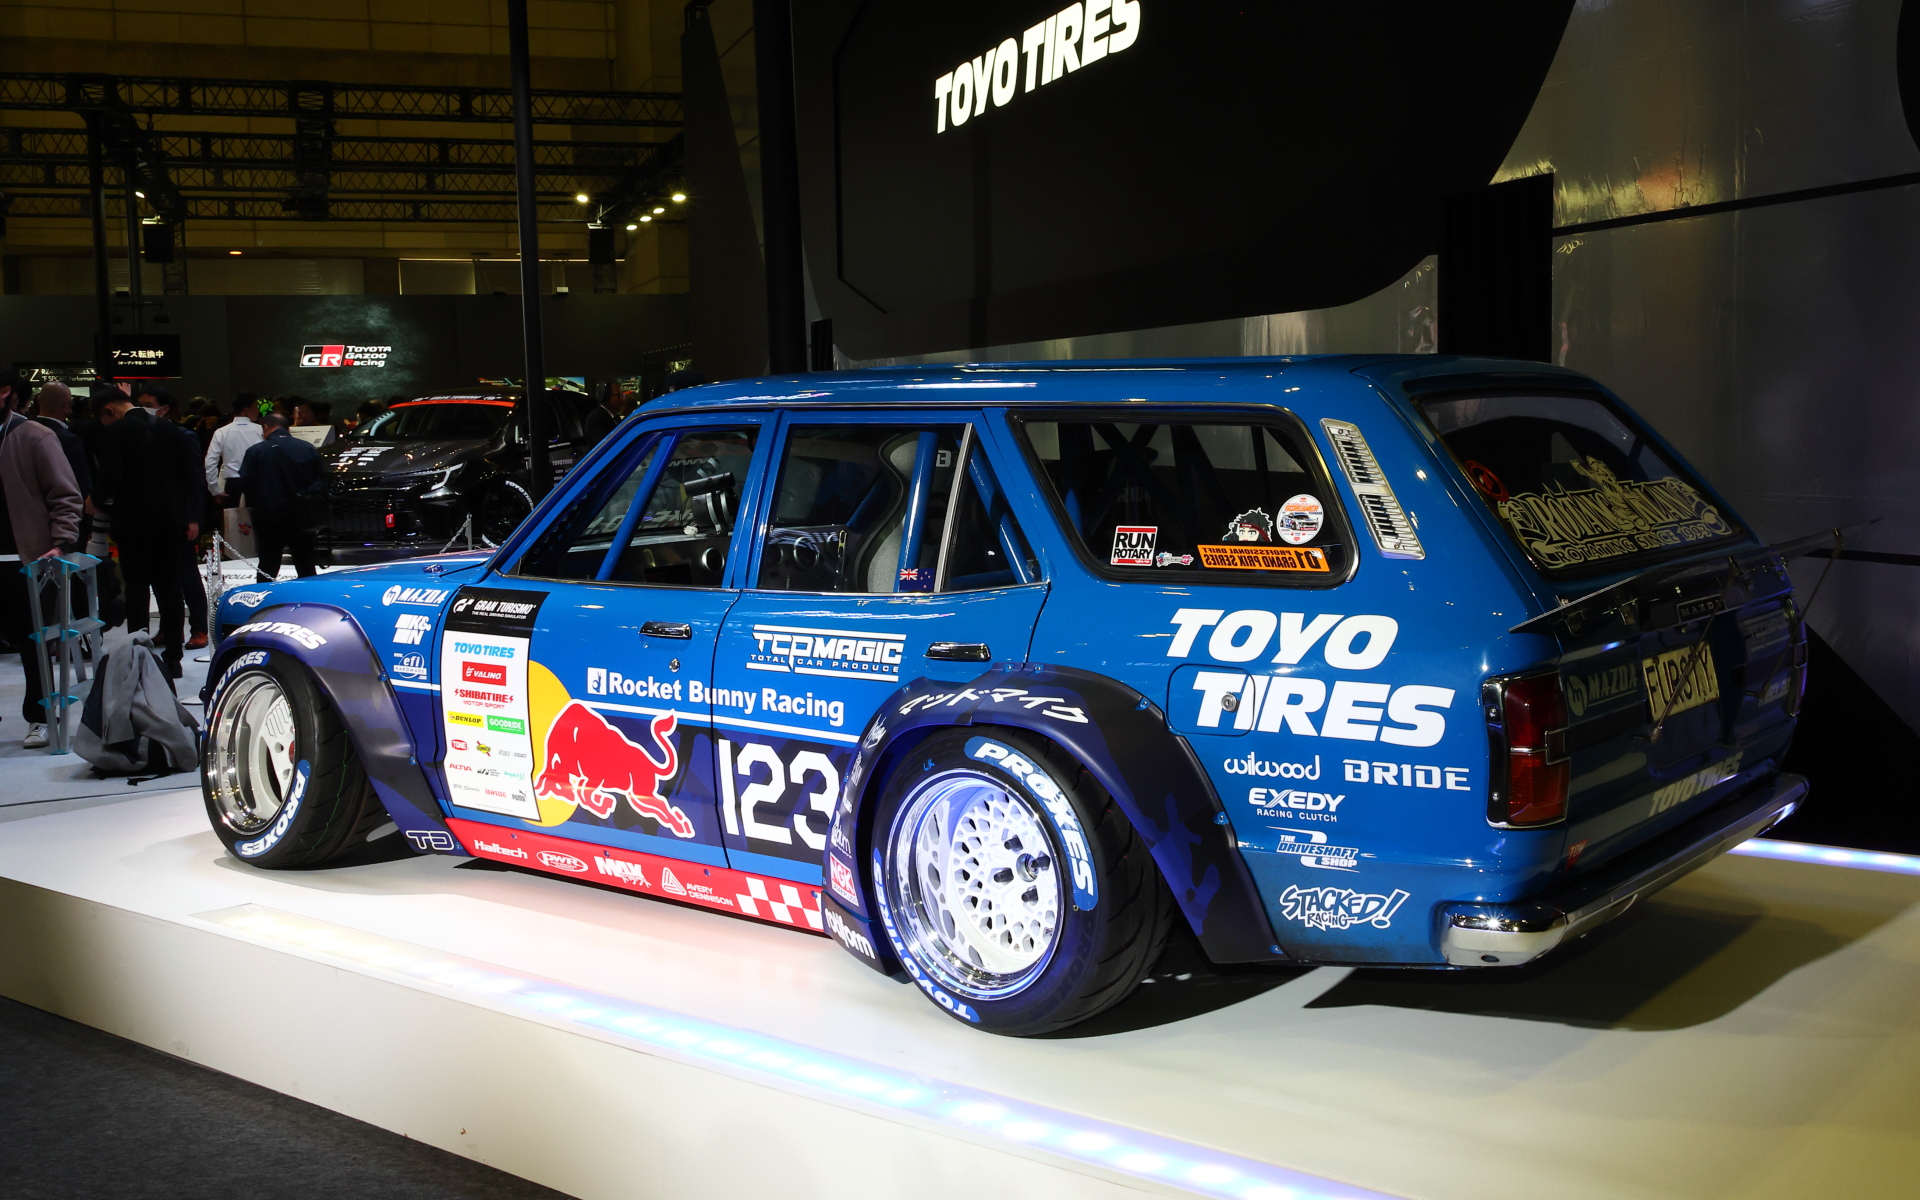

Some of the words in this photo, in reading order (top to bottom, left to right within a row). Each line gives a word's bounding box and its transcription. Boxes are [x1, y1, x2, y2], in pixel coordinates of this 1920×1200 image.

[935, 37, 1019, 134] TOYO
[1022, 0, 1141, 94] TIRES
[112, 350, 165, 359] ブース転換中
[345, 352, 388, 360] GAZOO
[346, 345, 393, 353] TOYOTA
[302, 353, 341, 366] GR
[343, 359, 386, 368] Racing
[505, 480, 525, 493] TOYO
[1115, 533, 1156, 549] RUN
[1553, 535, 1638, 563] ROTATING
[1634, 527, 1681, 550] SINCE
[1679, 523, 1712, 542] 1993
[1113, 548, 1153, 560] ROTARY
[400, 587, 449, 604] MAZDA
[473, 600, 497, 613] GRAN
[498, 601, 535, 615] TURISMO
[265, 621, 328, 650] TIRES
[1166, 607, 1399, 670] TOYO
[454, 642, 483, 655] TOYO
[483, 645, 515, 659] TIRES
[227, 651, 268, 679] TIRES
[394, 665, 427, 674] HARDWARE
[403, 655, 420, 668] efi
[750, 653, 786, 664] TOTAL
[797, 657, 824, 667] CAR
[832, 660, 900, 674] PRODUCE
[473, 670, 503, 680] VALINO
[1588, 663, 1638, 701] MAZDA
[459, 689, 509, 704] SHIBATIRE
[463, 699, 483, 707] MOTOR
[609, 672, 682, 701] Rocket
[688, 680, 758, 715] Bunny
[761, 687, 845, 727] Racing
[1192, 671, 1456, 747] TIRES
[455, 715, 483, 724] DUNLOP
[489, 718, 524, 730] GOODRIDE
[1223, 751, 1321, 781] wilwood
[1342, 758, 1471, 792] BRIDE
[1648, 773, 1698, 818] TOYO
[1696, 751, 1744, 796] TIRES
[484, 789, 508, 798] BRIDE
[718, 738, 840, 851] 123
[1248, 787, 1346, 813] EXEDY
[241, 768, 306, 856] PROXES
[973, 741, 1095, 897] PROXES
[1256, 808, 1293, 819] RACING
[1299, 811, 1338, 823] CLUTCH
[1280, 834, 1297, 842] THE
[474, 839, 528, 859] Haltech
[1277, 841, 1359, 859] DRIVESHAFT
[541, 852, 579, 867] PWR
[593, 855, 645, 880] MAX
[1319, 856, 1358, 868] SHOP
[831, 854, 856, 898] NGK
[686, 882, 714, 894] AVERY
[687, 889, 734, 907] DENNISON
[873, 857, 908, 957] TIRES
[1280, 885, 1411, 929] STACKED!
[902, 956, 971, 1020] TOYO
